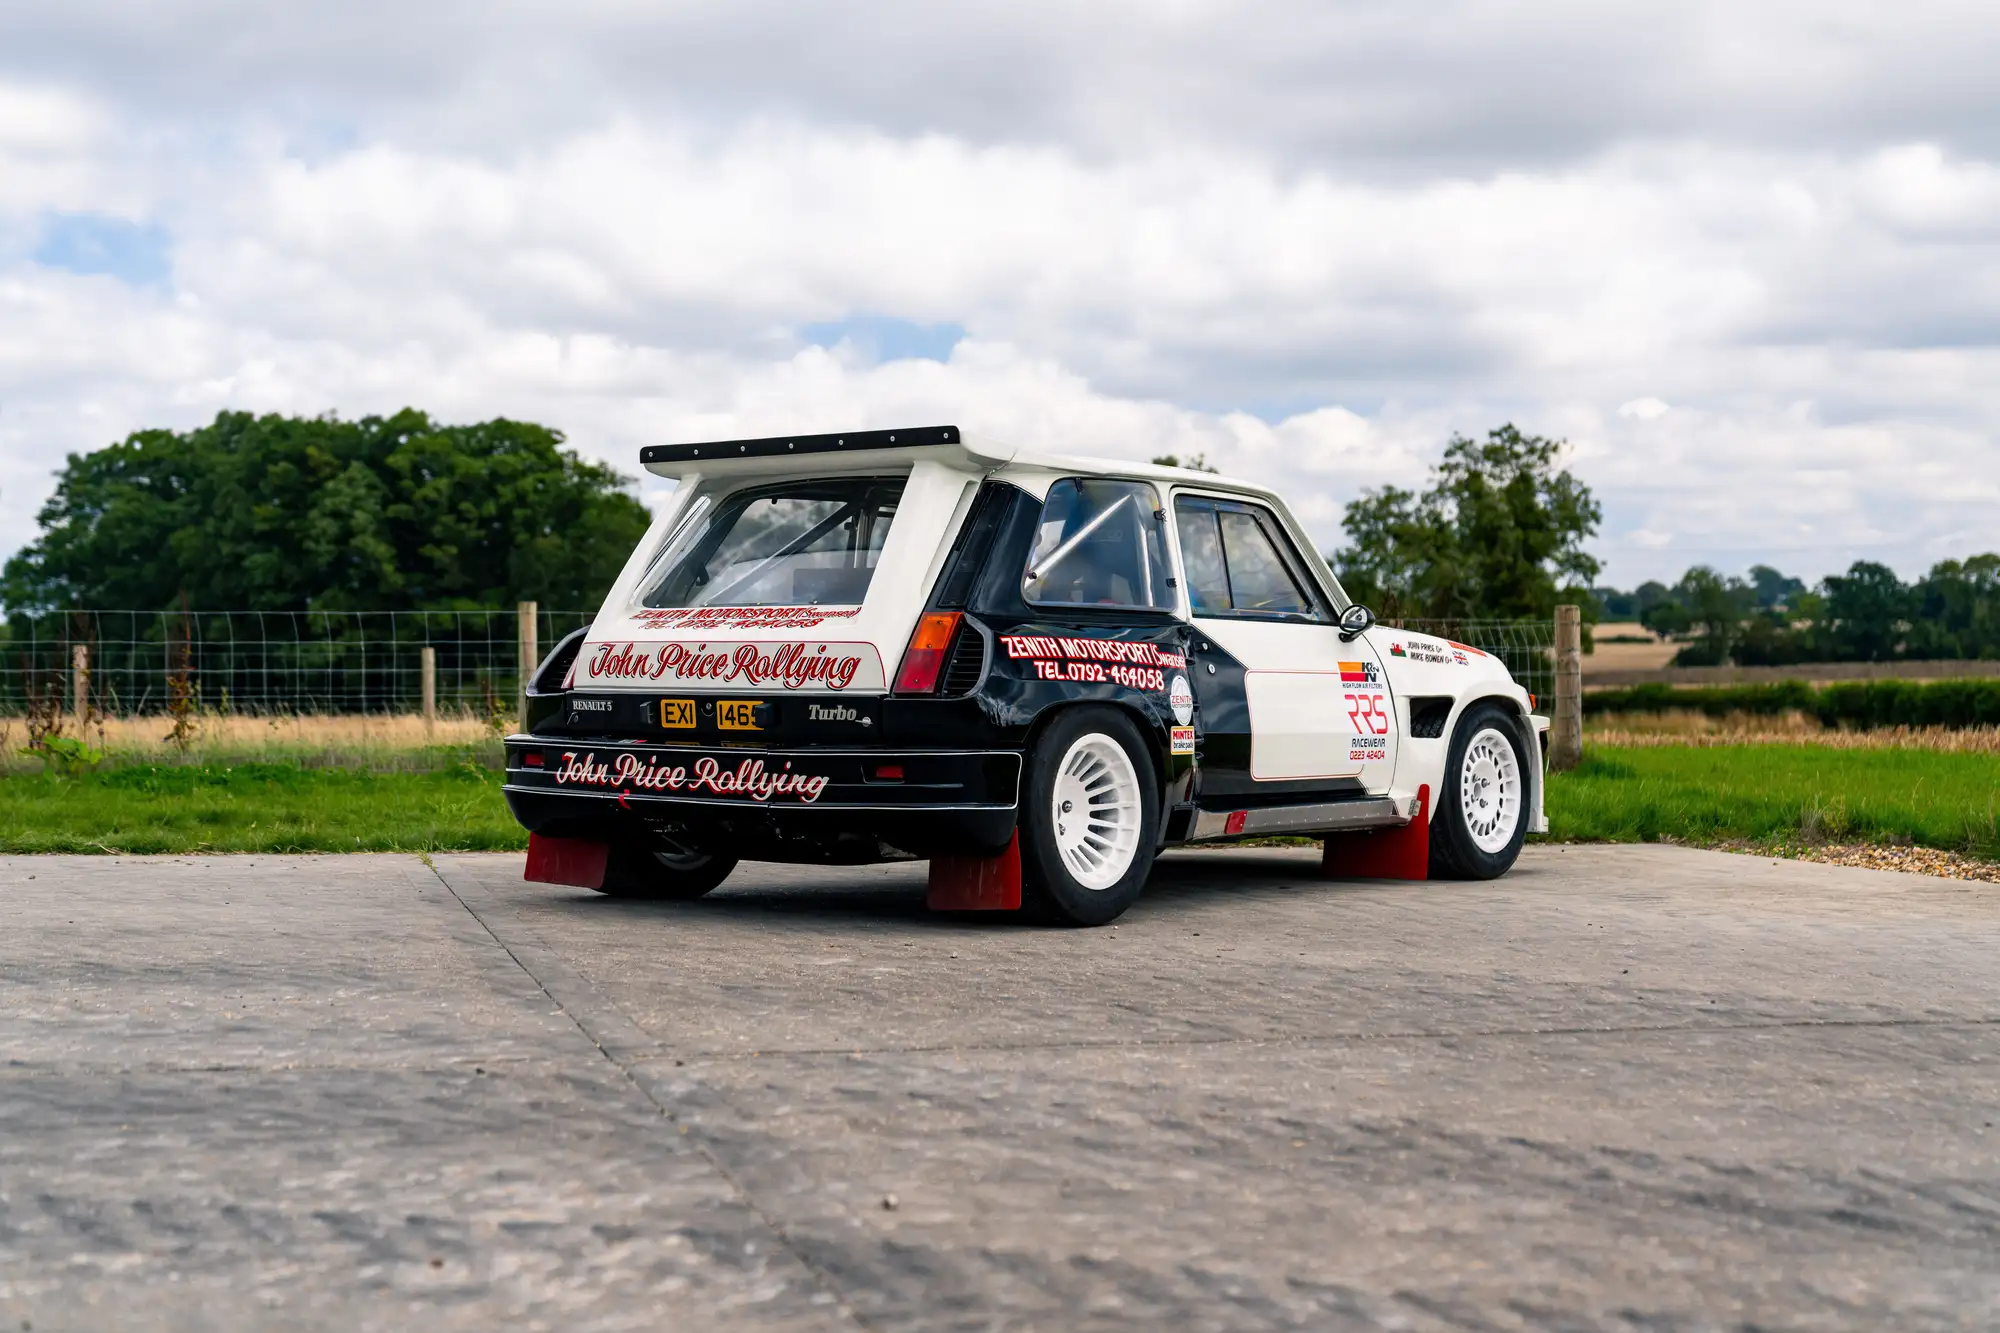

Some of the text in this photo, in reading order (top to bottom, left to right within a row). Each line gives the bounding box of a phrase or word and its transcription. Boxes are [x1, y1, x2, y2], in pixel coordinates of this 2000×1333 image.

[630, 609, 695, 620] ZENITH
[688, 607, 807, 620] MOTORSPORT
[672, 618, 825, 629] 0792-464058
[1000, 636, 1062, 658] ZENITH
[1059, 638, 1154, 664] MOTORSPORT
[1407, 641, 1420, 649] JOHN
[1410, 652, 1425, 662] MIKE
[1425, 654, 1444, 664] BOWEN
[589, 642, 862, 691] John Price Rallying
[572, 700, 613, 711] RENAULT 5
[1171, 695, 1192, 704] ZENITH
[664, 702, 694, 725] EXI
[808, 704, 857, 721] Turbo
[1344, 694, 1388, 734] RRS
[1173, 731, 1193, 740] MINTEX
[1351, 738, 1386, 748] RACEWEAR
[1349, 750, 1385, 760] 0223 42404
[555, 752, 830, 803] John Price Rallying
